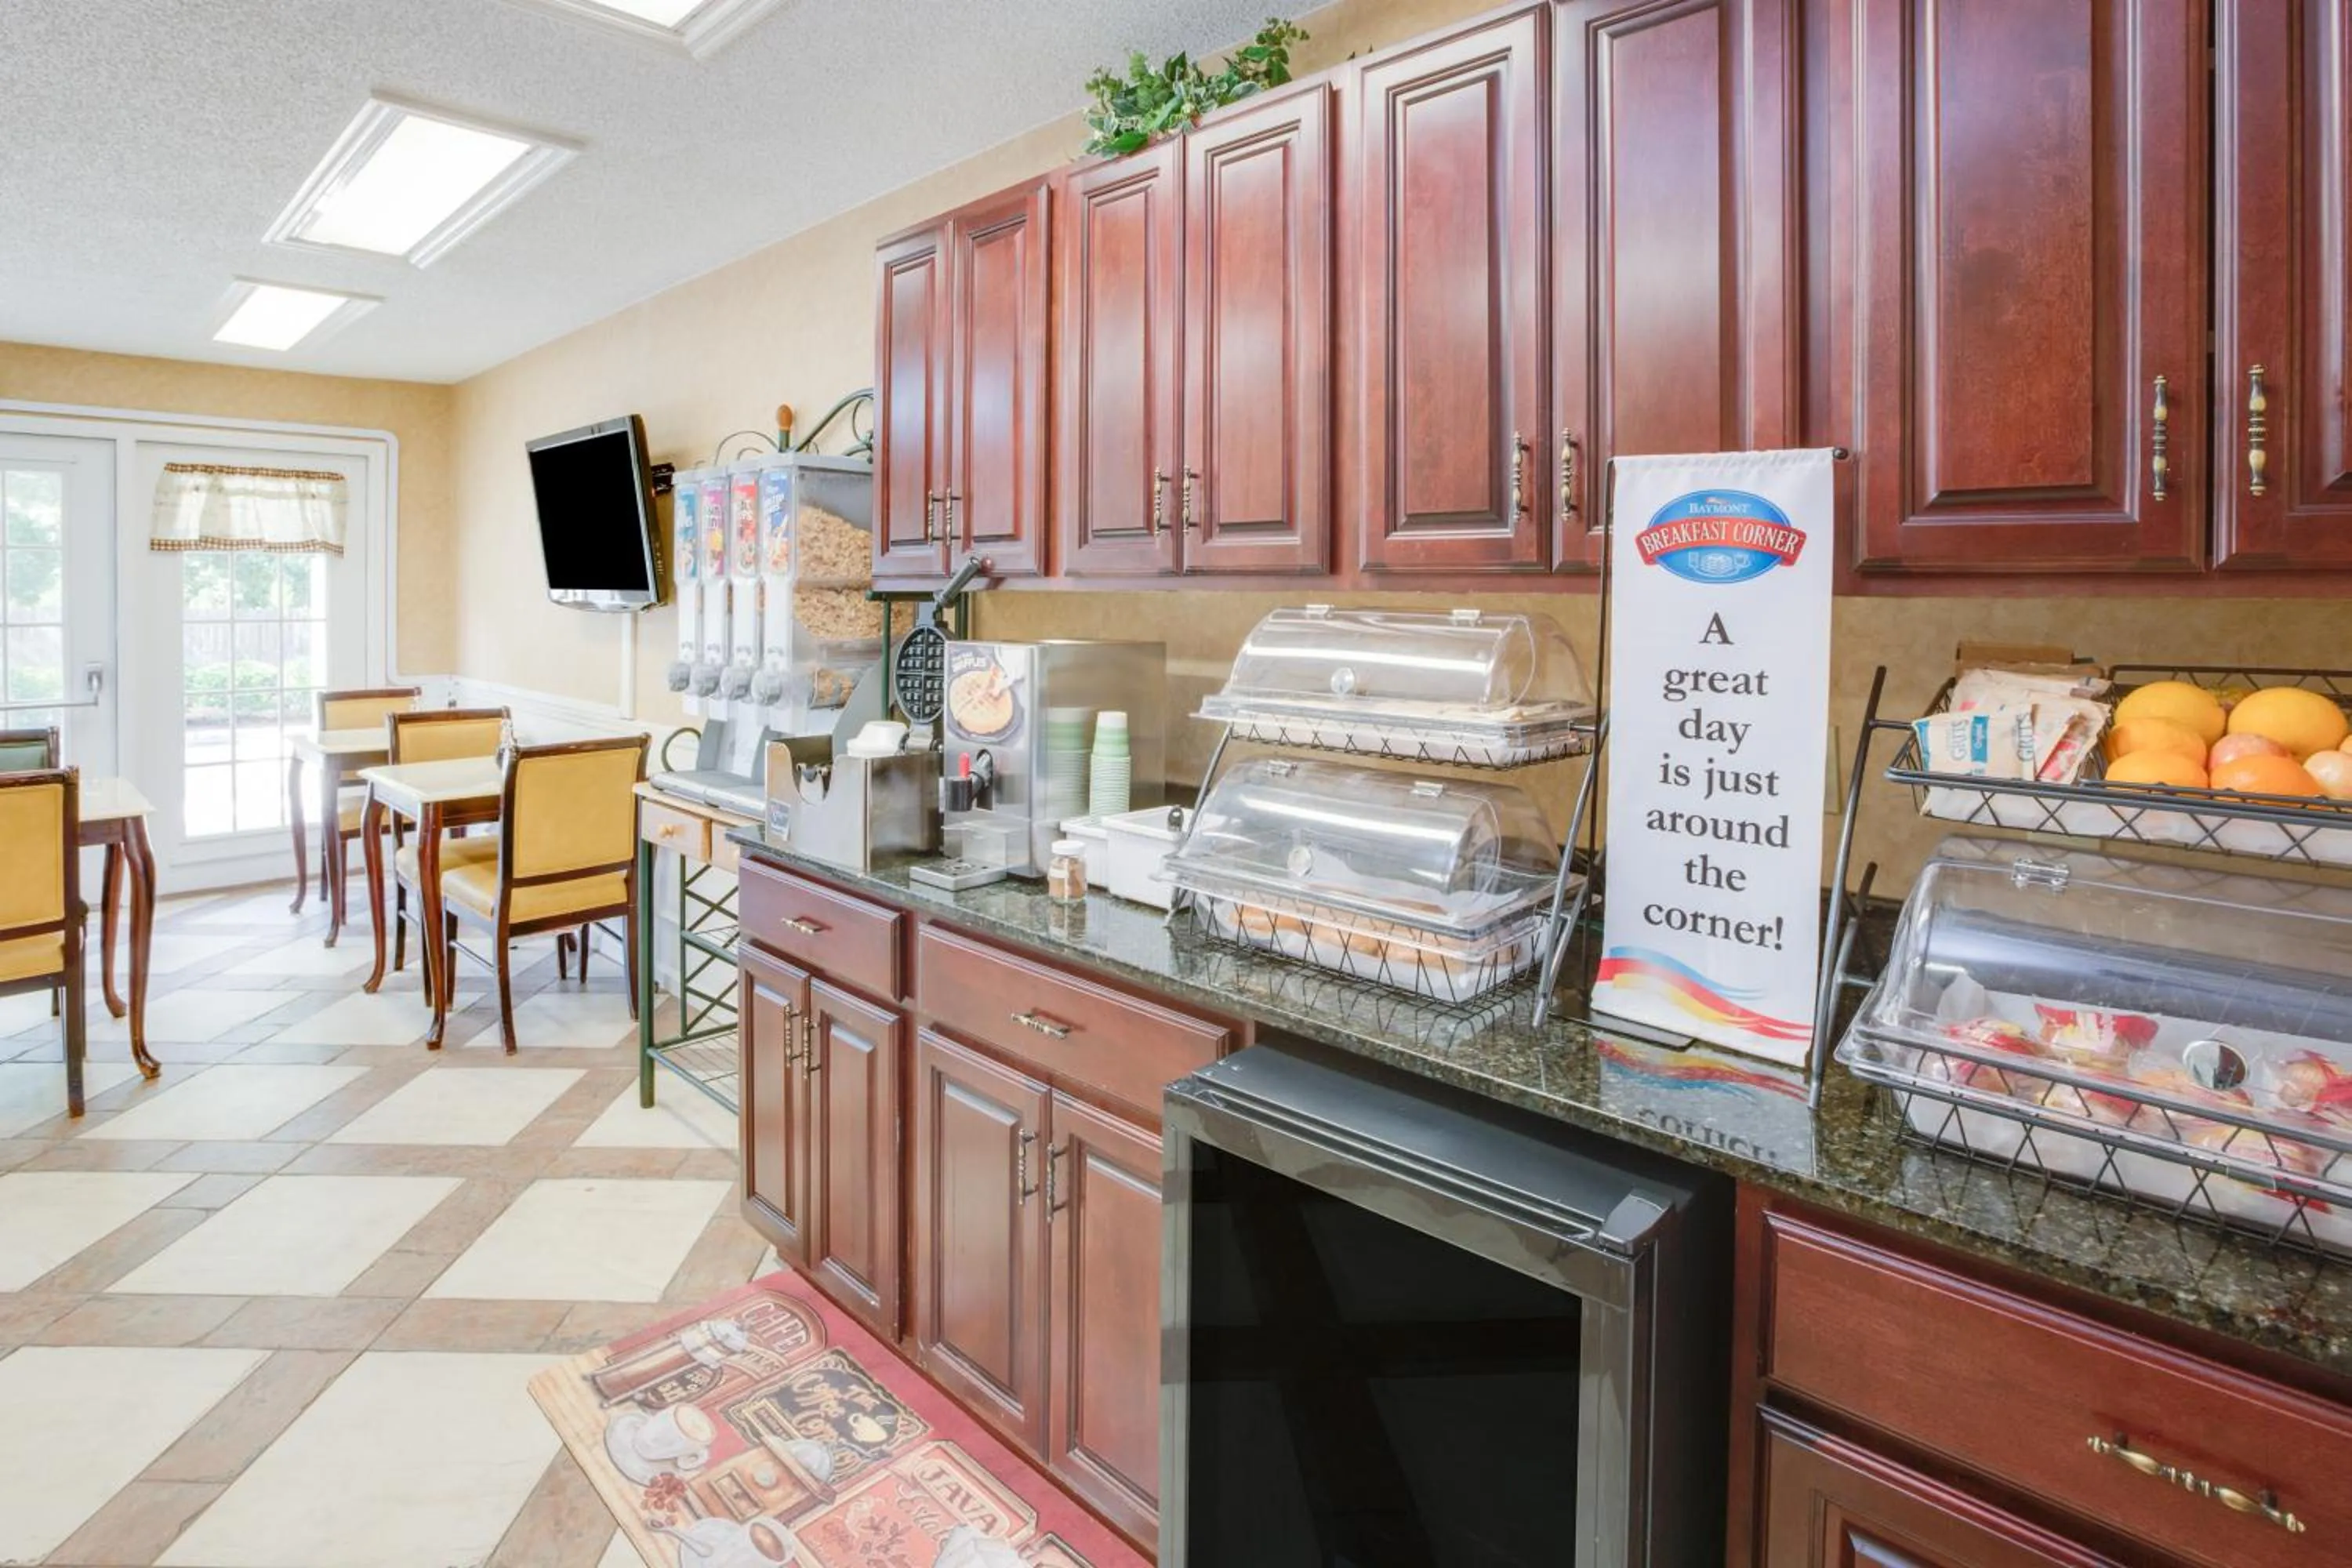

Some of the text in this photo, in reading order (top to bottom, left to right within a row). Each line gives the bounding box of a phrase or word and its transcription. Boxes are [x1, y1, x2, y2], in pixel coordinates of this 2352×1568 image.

[1688, 503, 1749, 514] BAYMONT
[1641, 521, 1798, 555] BREAKFAST CORNER
[1699, 612, 1734, 645] A
[1663, 668, 1769, 702] great
[1679, 708, 1751, 754] day
[1658, 753, 1779, 800] is just
[1646, 808, 1791, 849] around
[1684, 854, 1747, 892] the
[1643, 902, 1784, 951] corner!
[920, 1465, 999, 1534] JAVA
